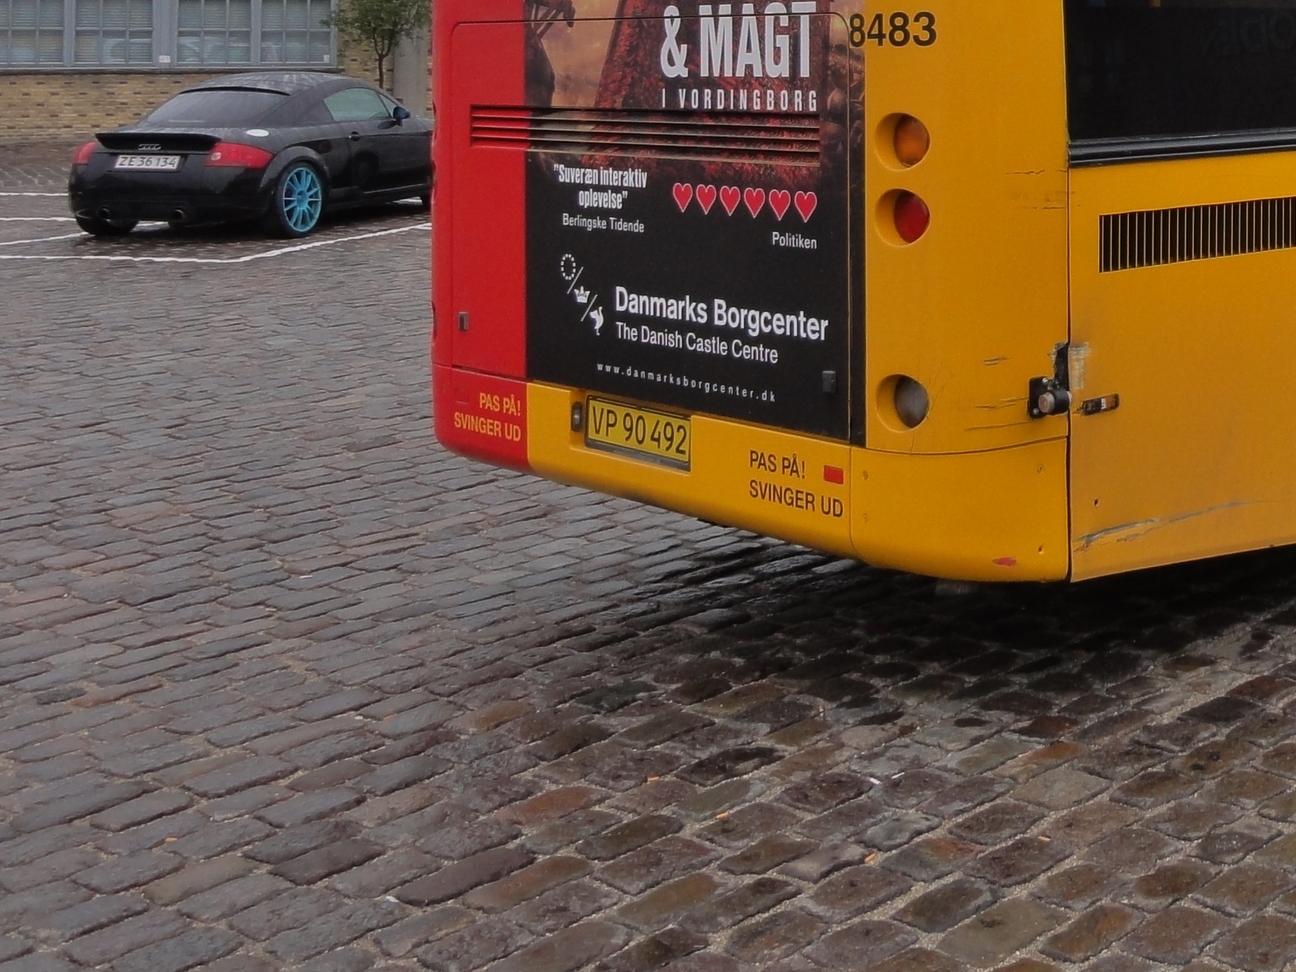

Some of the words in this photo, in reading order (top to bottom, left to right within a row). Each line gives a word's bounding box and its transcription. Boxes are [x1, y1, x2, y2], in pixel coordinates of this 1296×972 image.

[660, 4, 688, 78] &
[700, 1, 816, 78] MAGT
[849, 12, 937, 47] 8483
[661, 89, 666, 108] I
[679, 88, 817, 112] VORDINGBORG
[118, 156, 138, 166] ZE
[138, 157, 152, 167] 36
[156, 157, 177, 168] 134
[600, 168, 647, 188] interaktiv
[562, 213, 607, 231] Berlingske
[609, 216, 644, 233] Tidende
[772, 232, 817, 249] Politiken
[616, 286, 707, 323] Danmarks
[714, 299, 829, 340] Borgcenter
[616, 322, 638, 341] The
[641, 326, 682, 349] Danish
[686, 333, 728, 356] Castle
[732, 340, 778, 364] Centre
[597, 362, 775, 402] www.danmarksborgcenter.dk
[479, 392, 500, 412] PAS
[503, 395, 521, 416] PÅ!
[454, 412, 501, 437] SVINGER
[505, 423, 521, 442] UD
[592, 406, 617, 437] VP
[623, 412, 646, 445] 90
[650, 422, 687, 455] 492
[749, 450, 777, 474] PAS
[781, 453, 806, 479] PÅ!
[749, 480, 815, 513] SVINGER
[820, 492, 844, 518] UD
